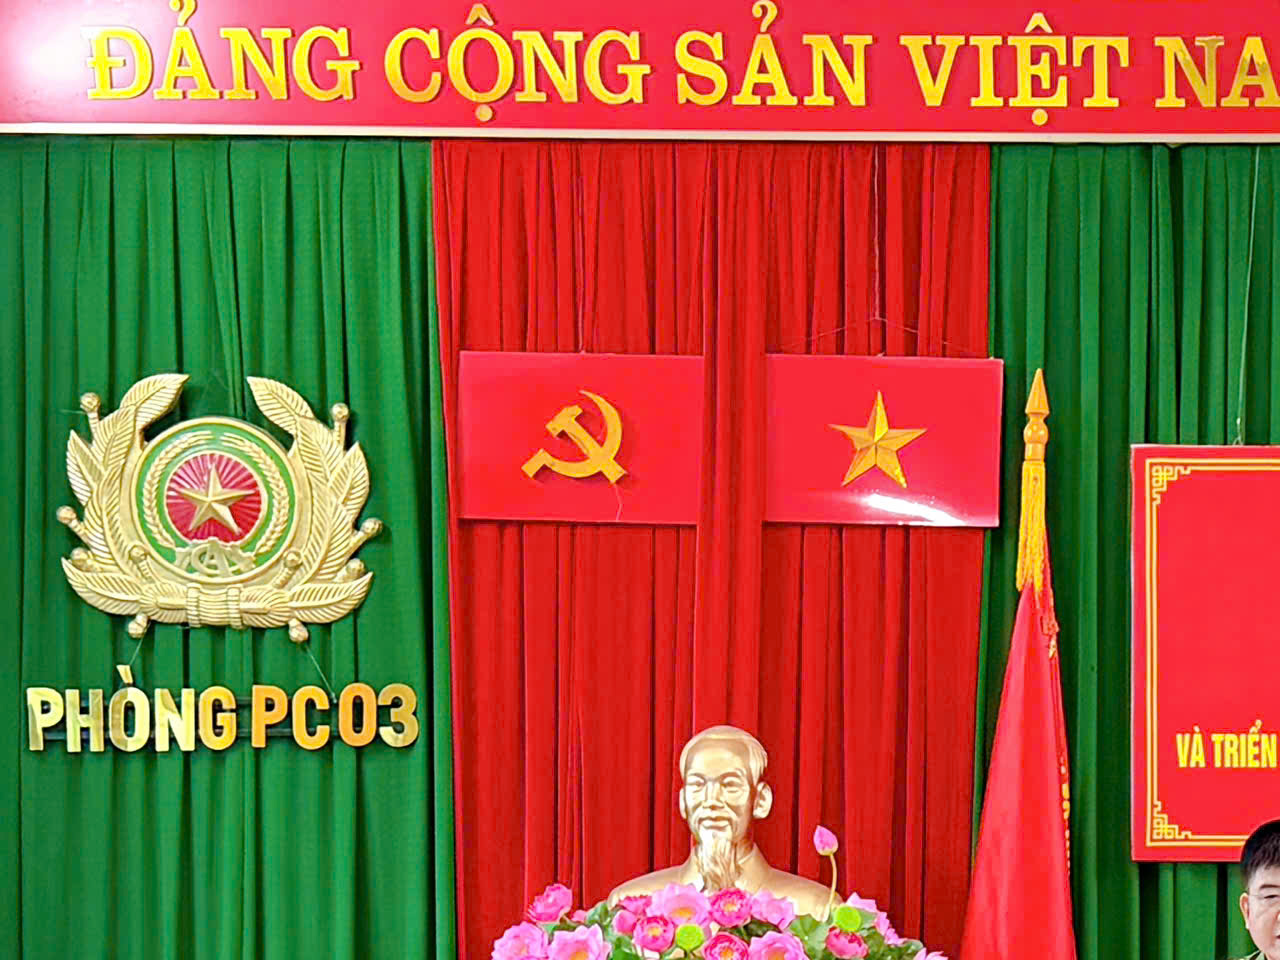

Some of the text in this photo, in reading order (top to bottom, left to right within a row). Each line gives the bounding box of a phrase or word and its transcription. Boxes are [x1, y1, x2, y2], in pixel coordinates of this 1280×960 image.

[84, 0, 361, 102] ĐẢNG
[383, 3, 652, 122] CỘNG
[674, 0, 874, 107] SẢN
[899, 13, 1129, 127] VIỆT
[26, 664, 419, 752] PHÒNG PC03
[1175, 725, 1205, 767] VÀ
[1210, 718, 1277, 768] TRIỂN
